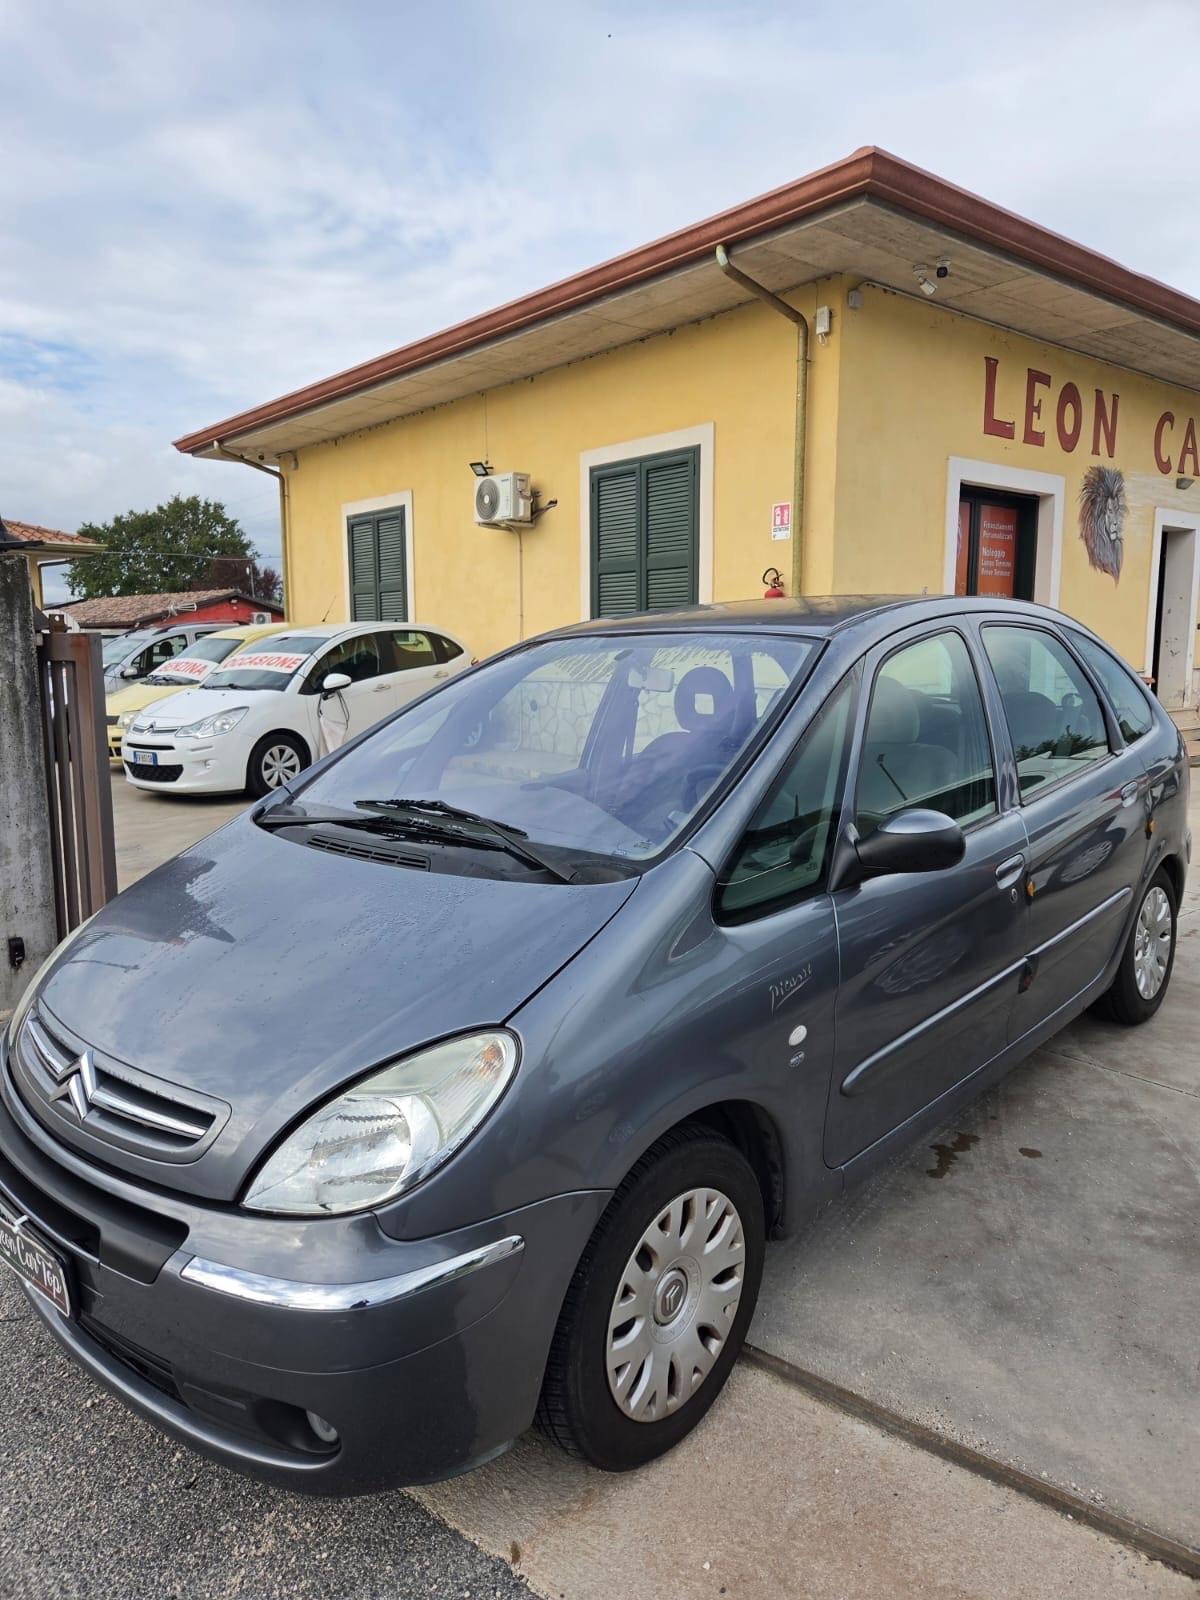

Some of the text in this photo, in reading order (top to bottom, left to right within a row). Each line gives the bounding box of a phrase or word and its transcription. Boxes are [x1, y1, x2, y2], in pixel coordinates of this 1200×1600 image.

[984, 356, 1119, 458] LEON
[982, 546, 1006, 559] Noleggio
[158, 660, 209, 677] BENZINA
[223, 655, 303, 670] OCCASIONE
[16, 1235, 39, 1274] Car
[36, 1252, 61, 1299] Top
